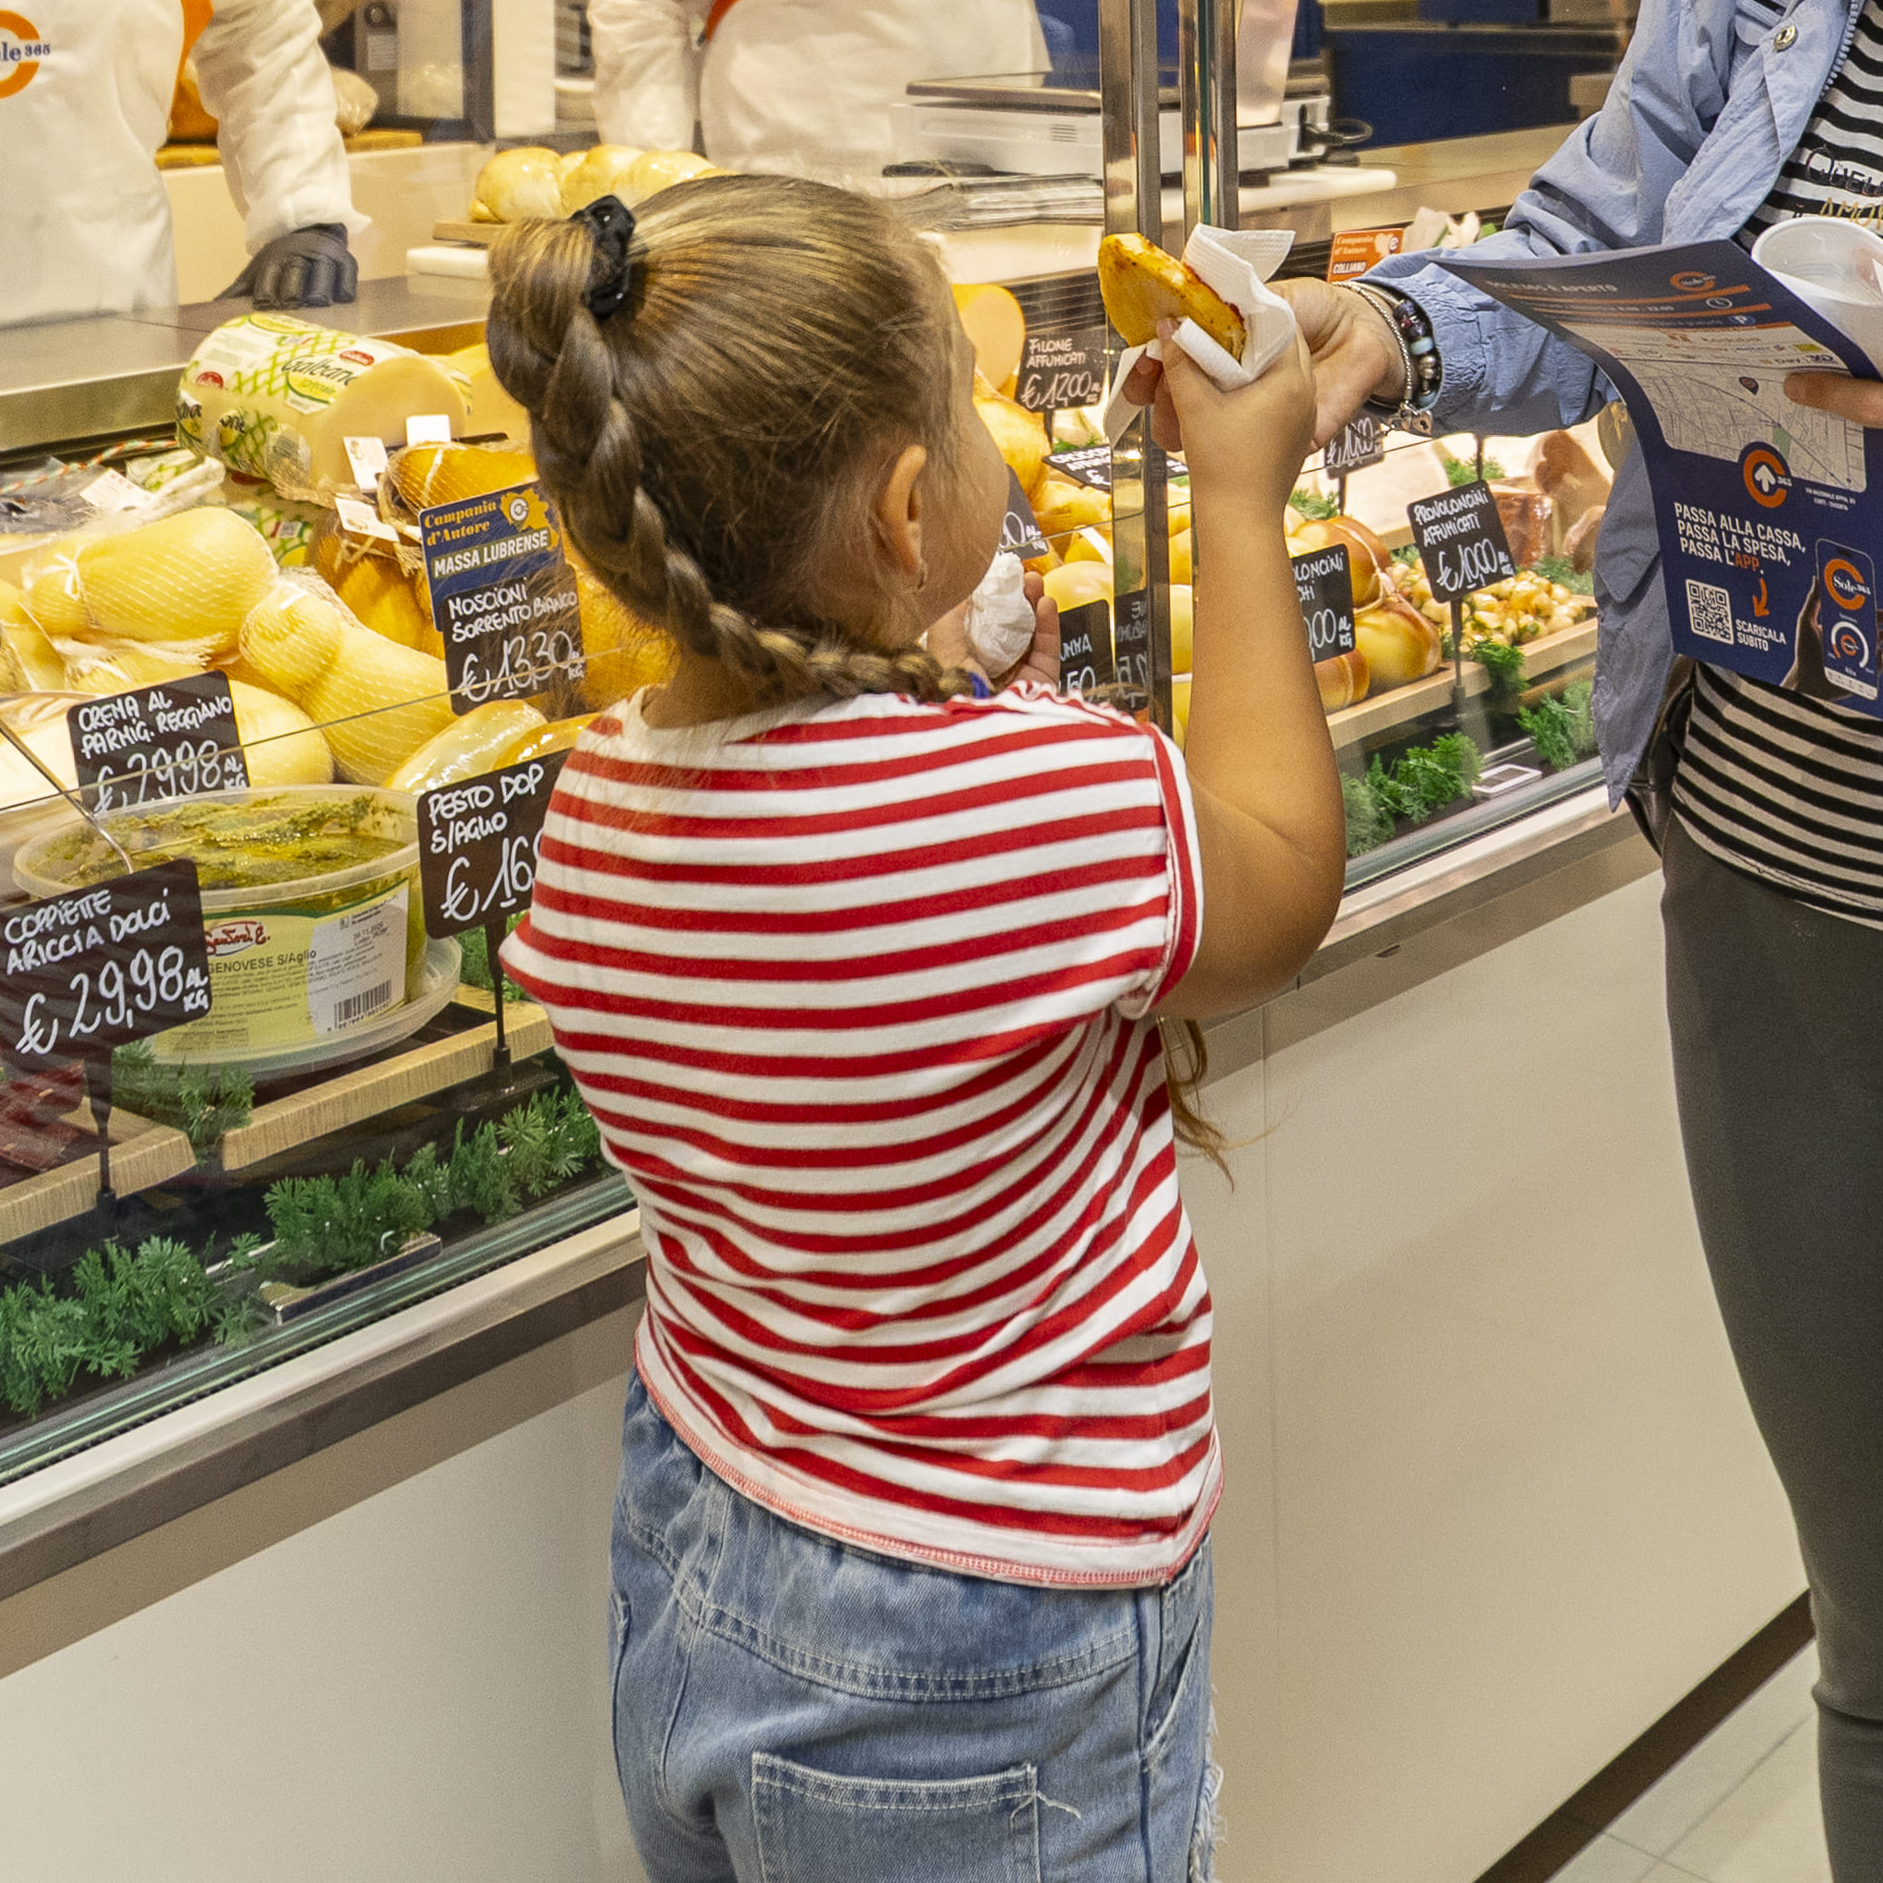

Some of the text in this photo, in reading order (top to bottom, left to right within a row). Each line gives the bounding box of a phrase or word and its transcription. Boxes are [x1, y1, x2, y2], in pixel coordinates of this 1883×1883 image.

[24, 43, 51, 57] 365
[1028, 338, 1073, 353] FILONE
[424, 500, 497, 530] Campania
[1414, 487, 1490, 526] PROVOLONCINI
[1674, 502, 1806, 553] PASSA ALLA CASSA,
[426, 518, 491, 547] d'Autore
[434, 530, 549, 577] MASSA LUBRENSE
[1677, 519, 1792, 567] PASSA LA SPESA,
[1680, 537, 1723, 562] PASSA
[1457, 538, 1498, 590] 10,00
[1833, 575, 1858, 593] Sole
[448, 578, 528, 622] MOSCIONI
[452, 591, 578, 644] SORRENTO BIANCO
[1735, 619, 1787, 645] SCARICALA
[1737, 631, 1769, 651] SUBITO
[492, 631, 574, 697] 13,30
[77, 691, 174, 731] CREMA AL
[81, 694, 233, 759] PARMIG. REGGIANO
[123, 739, 222, 807] 29,98
[428, 762, 544, 824] PESTO DOP
[431, 812, 508, 855] S/AGLIO
[442, 856, 479, 921] €
[3, 889, 112, 945] COPPIETTE
[5, 925, 104, 977] ARICCIA
[108, 887, 172, 942] DOLCI
[208, 948, 317, 975] GENOVESE S/Aglio
[16, 945, 186, 1055] € 29,98
[183, 990, 210, 1012] KG
